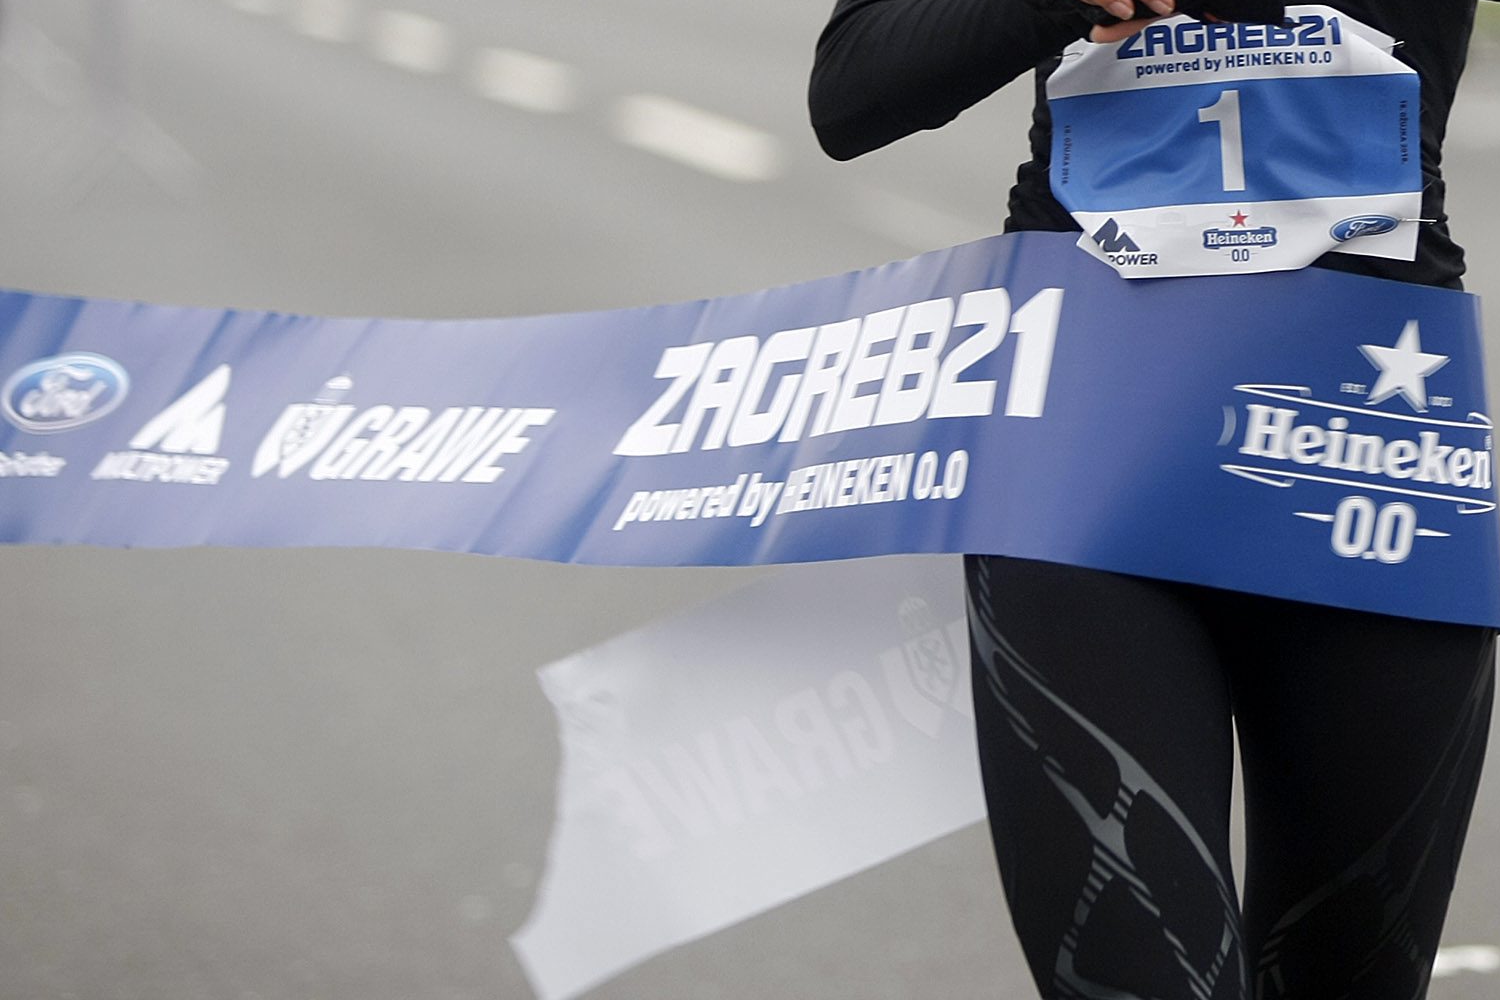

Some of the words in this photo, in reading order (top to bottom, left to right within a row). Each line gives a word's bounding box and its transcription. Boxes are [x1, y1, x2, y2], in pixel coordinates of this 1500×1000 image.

[1117, 15, 1341, 60] ZAGREB21
[1136, 58, 1200, 79] powered
[1204, 57, 1223, 73] by
[1225, 51, 1304, 69] HEINEKEN
[1309, 51, 1333, 64] 0.0
[1198, 90, 1245, 192] 1
[1206, 230, 1274, 246] Heineken
[612, 287, 1066, 457] ZAGREB21
[309, 406, 557, 483] GRAWE
[1238, 403, 1493, 490] Heineken
[611, 473, 749, 532] powered
[737, 472, 785, 528] by
[776, 452, 916, 516] HEINEKEN
[912, 449, 970, 501] 0.0
